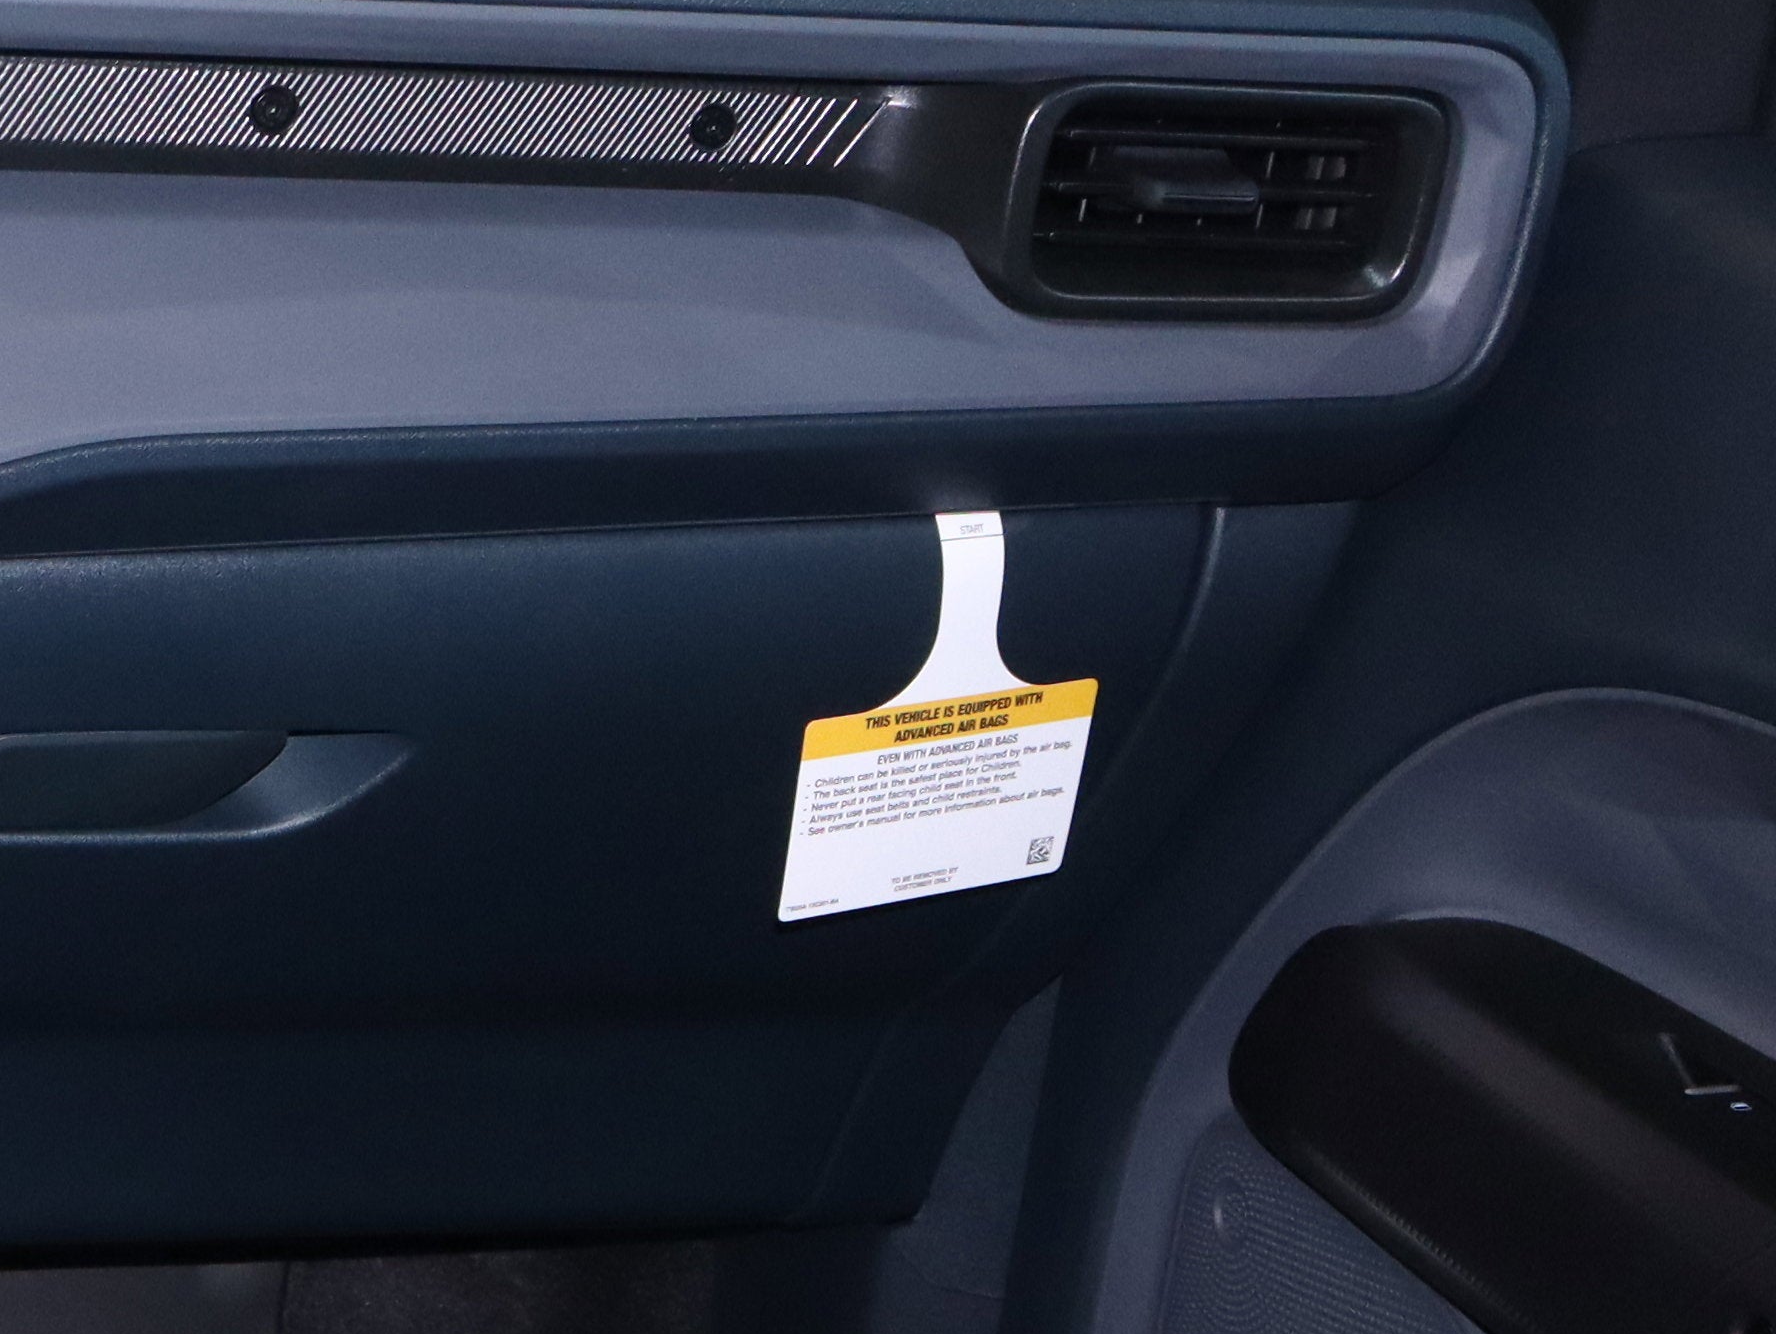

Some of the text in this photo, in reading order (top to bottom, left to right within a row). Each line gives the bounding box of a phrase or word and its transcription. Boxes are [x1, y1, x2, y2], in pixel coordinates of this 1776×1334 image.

[960, 523, 984, 534] START
[865, 691, 1044, 730] THIS VEHICLE IS EQUIPPED WITH
[894, 714, 1009, 743] ADVANCED AIR BAGS
[814, 775, 855, 788] Children
[857, 772, 874, 781] can
[876, 769, 889, 779] be
[891, 764, 916, 776] killed
[918, 764, 928, 772] or
[930, 755, 973, 770] seriously
[975, 749, 1008, 764] injured
[1009, 748, 1021, 759] by
[1023, 744, 1037, 755] the
[1039, 743, 1052, 753] air
[877, 733, 1019, 765] EVEN WITH ADVANCED AIR BAGS
[811, 800, 839, 812] Never
[841, 797, 857, 810] put
[866, 793, 886, 804] rear
[887, 786, 917, 800] facing
[919, 784, 942, 795] child
[944, 780, 964, 791] seat
[965, 777, 975, 787] in
[976, 775, 991, 785] the
[814, 790, 831, 800] The
[833, 786, 855, 797] back
[858, 782, 878, 793] seat
[880, 781, 889, 790] is
[891, 778, 907, 788] the
[908, 772, 937, 785] safest
[938, 767, 963, 782] place
[965, 766, 979, 776] for
[808, 826, 826, 837] See
[866, 815, 902, 827] manual
[903, 810, 916, 821] for
[918, 807, 943, 818] more
[944, 798, 997, 814] information
[999, 792, 1025, 805] about
[1026, 790, 1039, 800] air
[809, 811, 843, 825] Always
[846, 810, 863, 819] use
[865, 804, 885, 816] seat
[887, 799, 910, 812] belts
[912, 796, 932, 807] and
[932, 793, 954, 805] child
